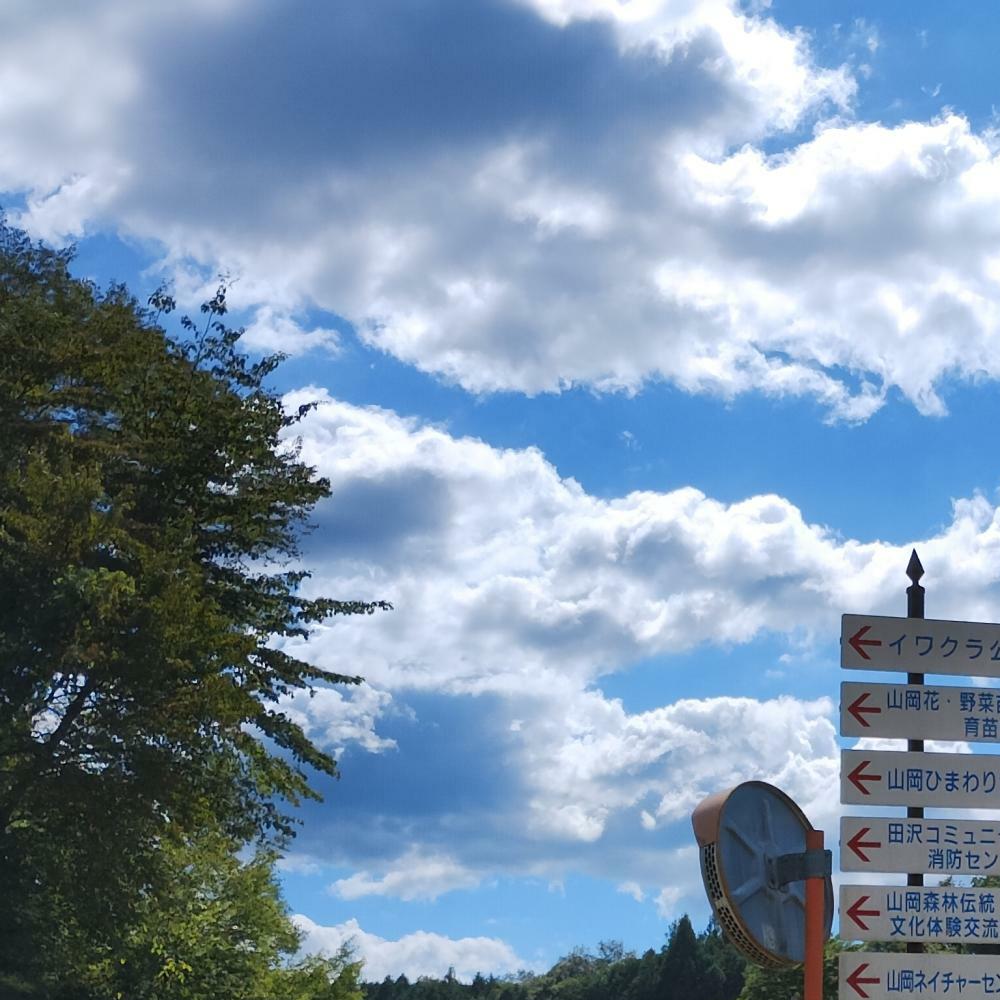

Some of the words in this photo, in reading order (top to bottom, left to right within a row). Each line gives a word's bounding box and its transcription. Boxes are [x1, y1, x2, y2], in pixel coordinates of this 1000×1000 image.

[886, 890, 995, 914] 山岡森林伝統
